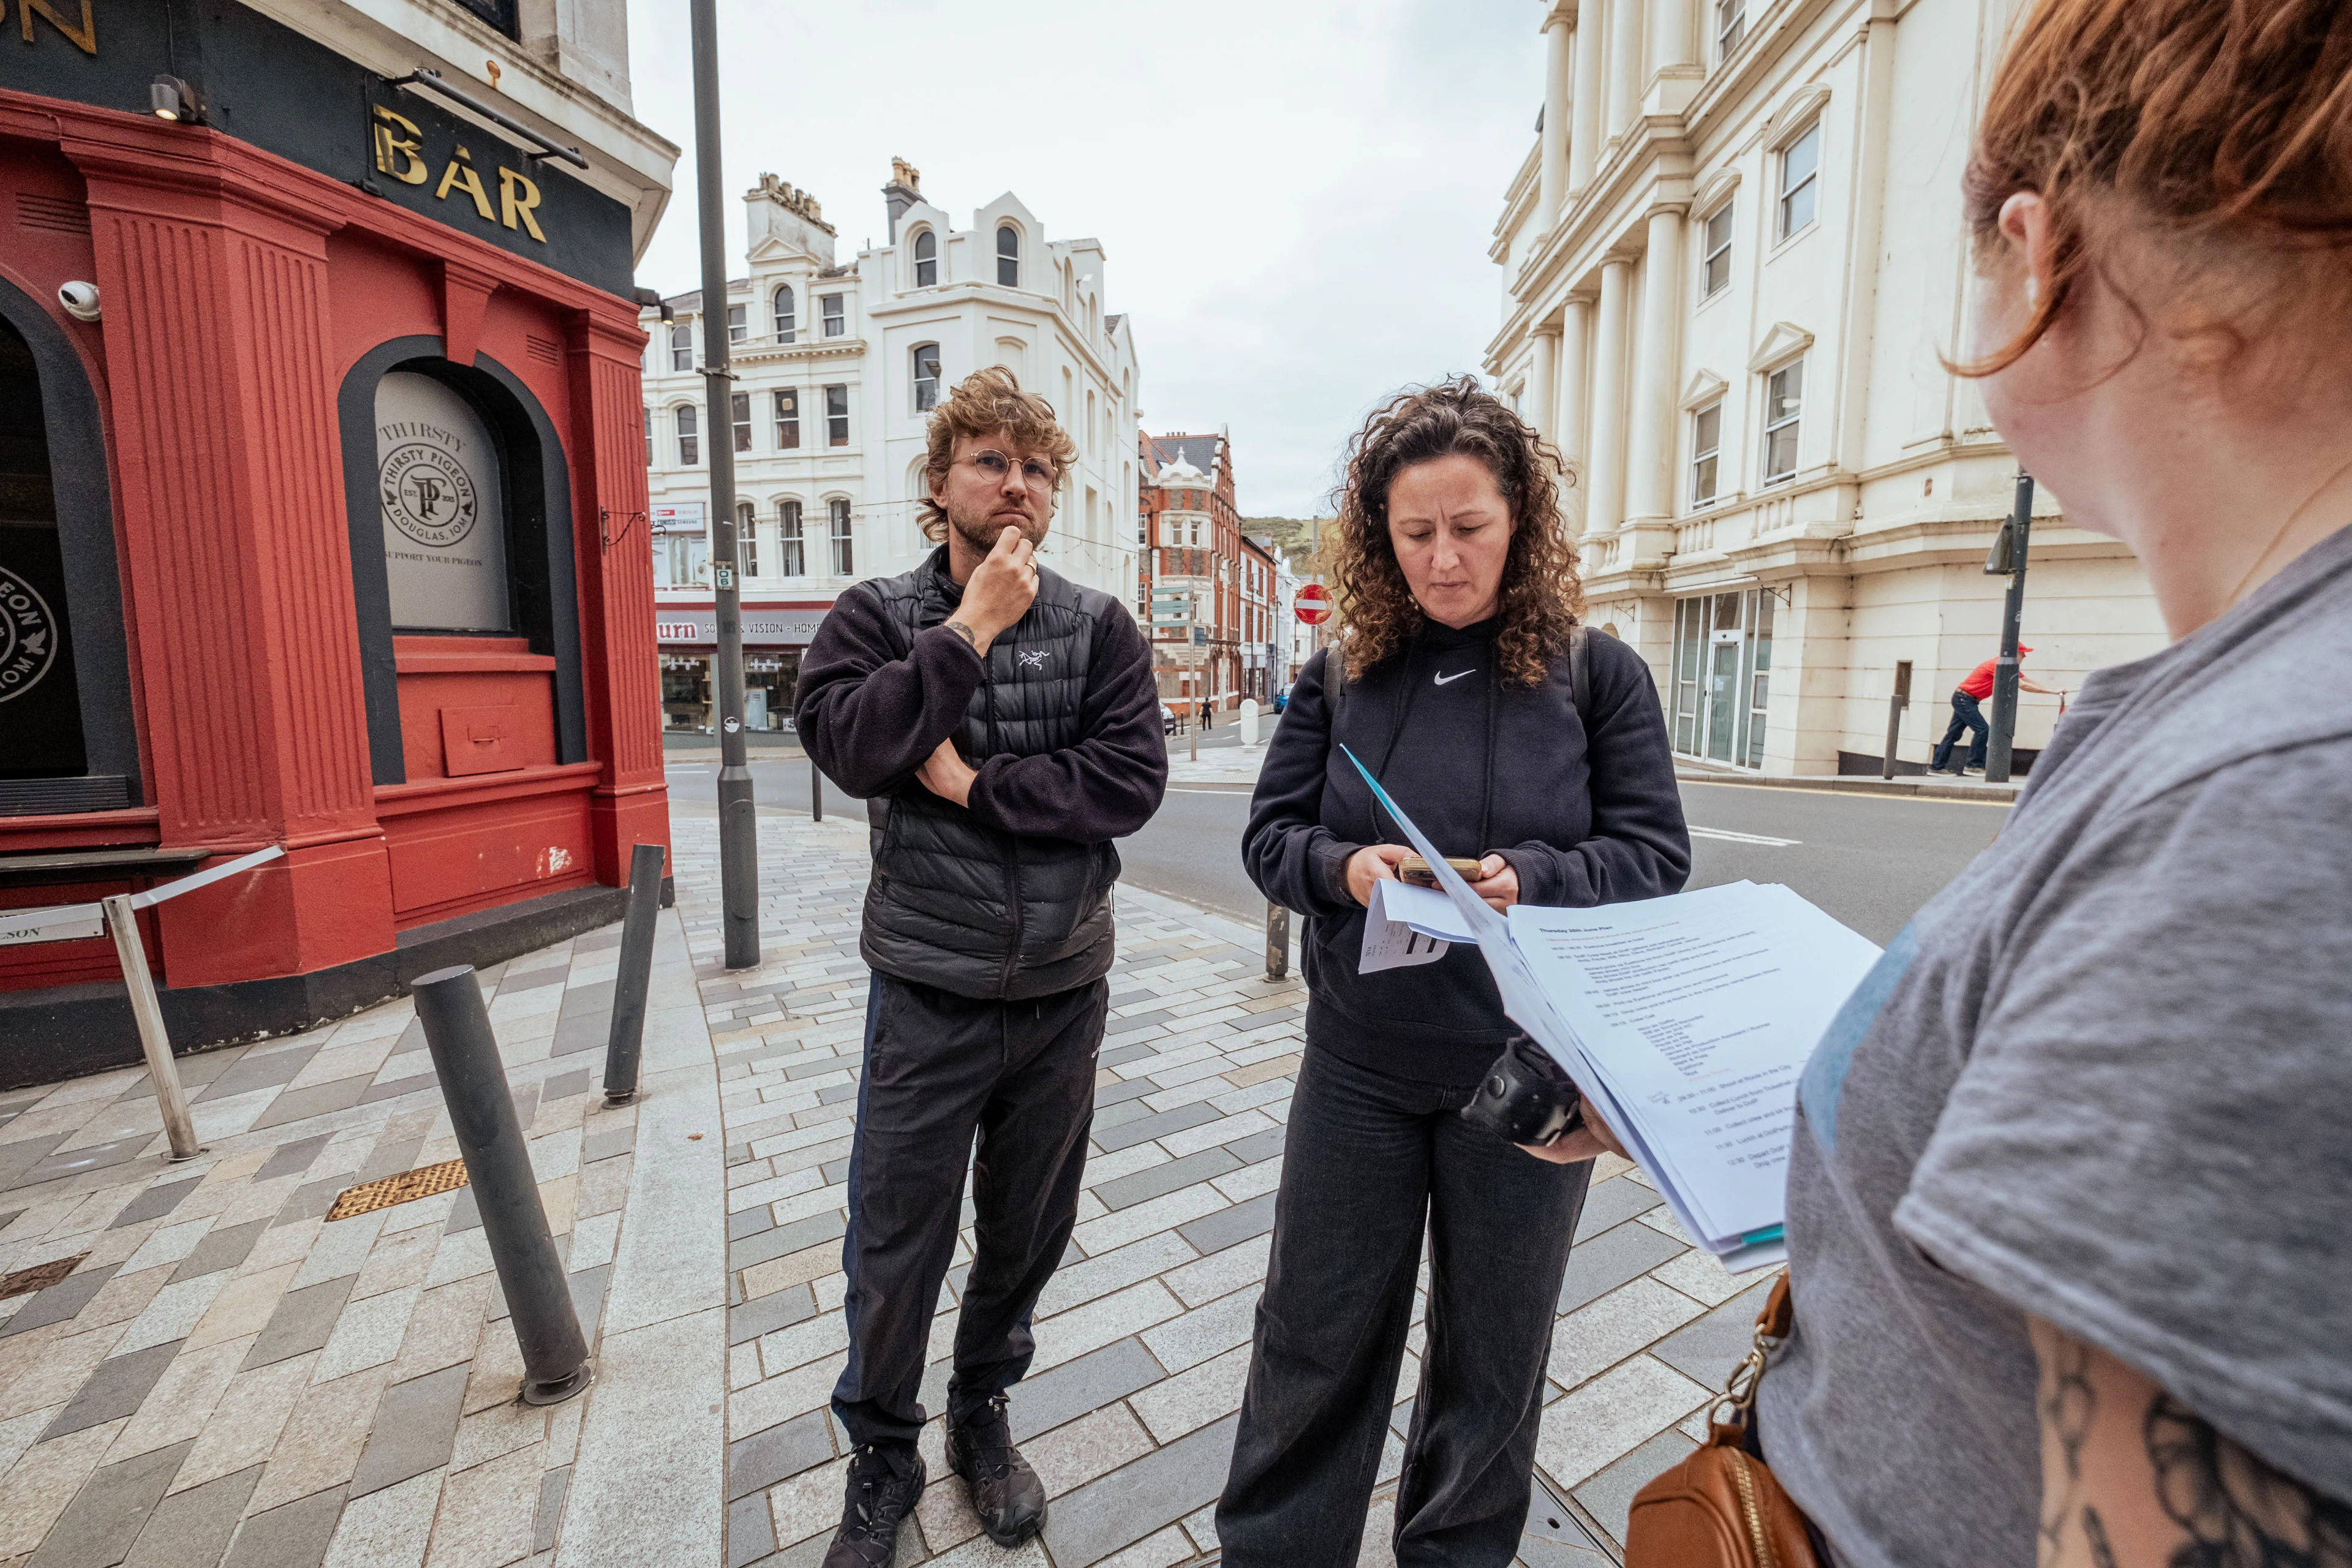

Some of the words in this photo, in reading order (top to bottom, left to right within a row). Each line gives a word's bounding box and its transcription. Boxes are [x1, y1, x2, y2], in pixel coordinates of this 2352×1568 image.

[372, 104, 546, 243] BAR
[379, 422, 466, 452] THIRSTY
[385, 450, 424, 485] THIRSTY
[431, 453, 470, 497] PIGEON
[449, 518, 468, 536] IOM
[426, 555, 450, 564] YOUR
[748, 623, 783, 633] VISION
